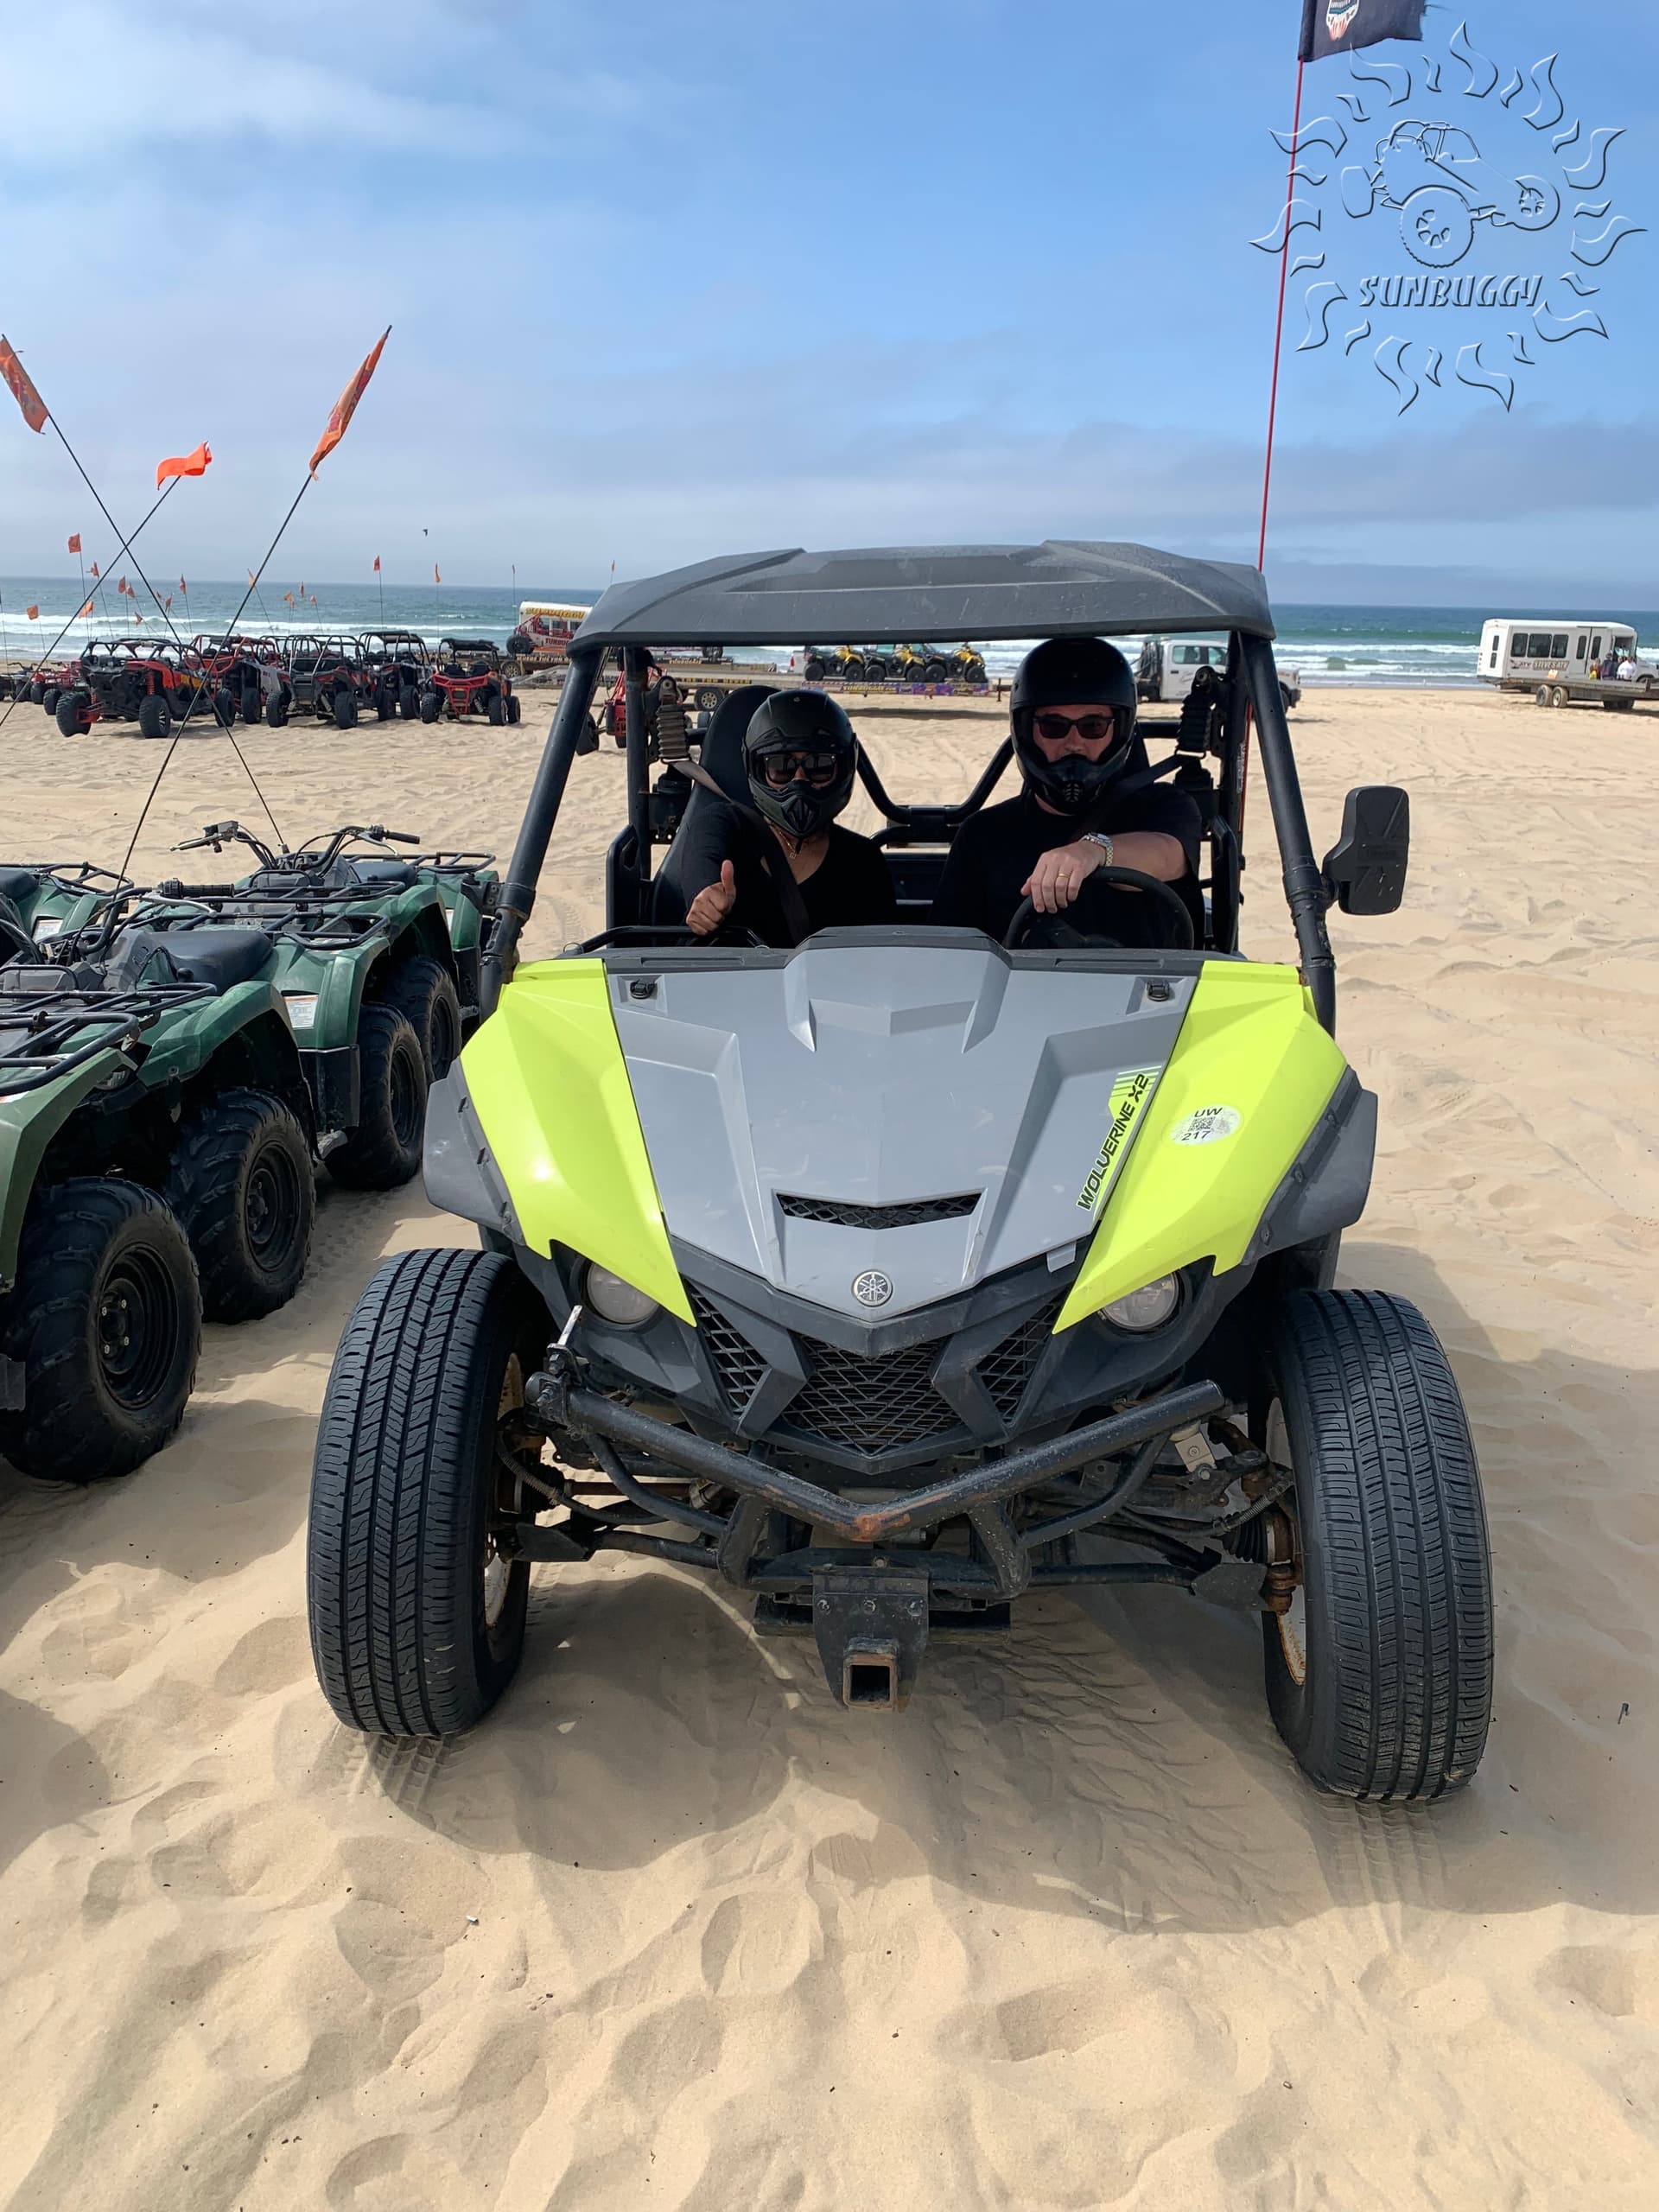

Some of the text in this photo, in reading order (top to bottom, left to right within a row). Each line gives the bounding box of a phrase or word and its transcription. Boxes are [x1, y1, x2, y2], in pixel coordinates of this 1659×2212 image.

[1194, 1107, 1224, 1118] UW
[1180, 1130, 1211, 1141] 217
[1077, 1074, 1149, 1210] WOLVERINE X2
